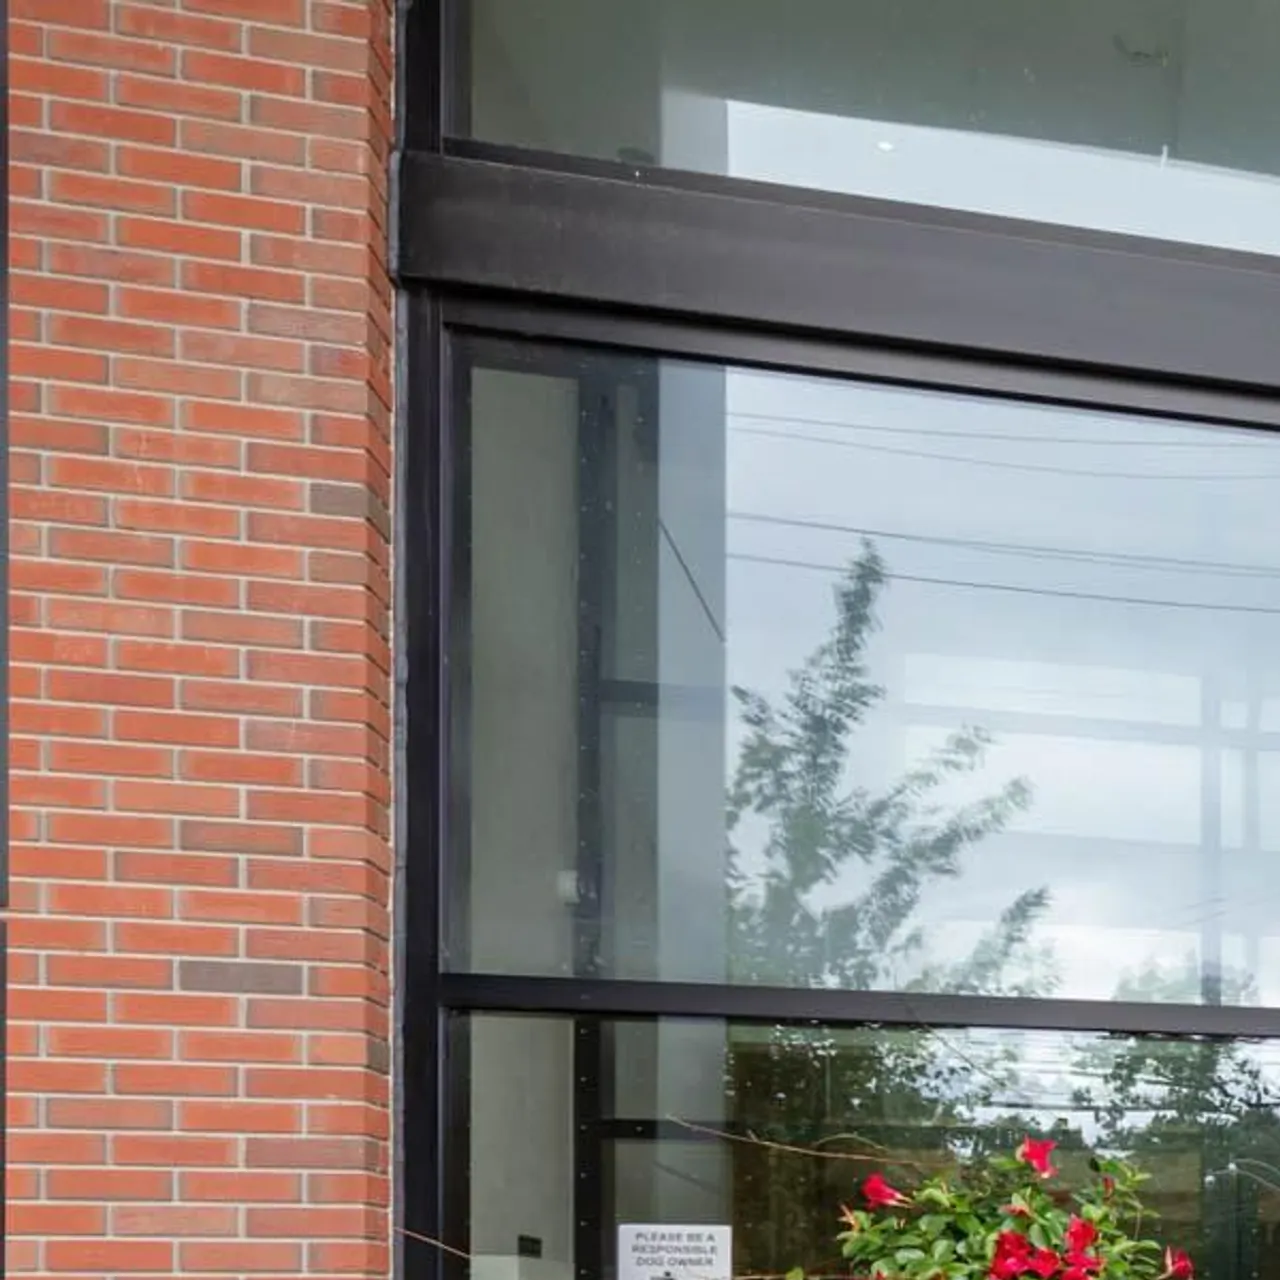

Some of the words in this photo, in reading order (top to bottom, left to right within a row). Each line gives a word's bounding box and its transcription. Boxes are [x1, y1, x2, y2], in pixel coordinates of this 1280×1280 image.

[635, 1232, 682, 1241] PLEASE
[687, 1232, 703, 1241] BE
[706, 1233, 716, 1241] A
[631, 1244, 717, 1254] RESPONSIBLE
[635, 1256, 664, 1266] DOG
[666, 1256, 714, 1266] OWNER
